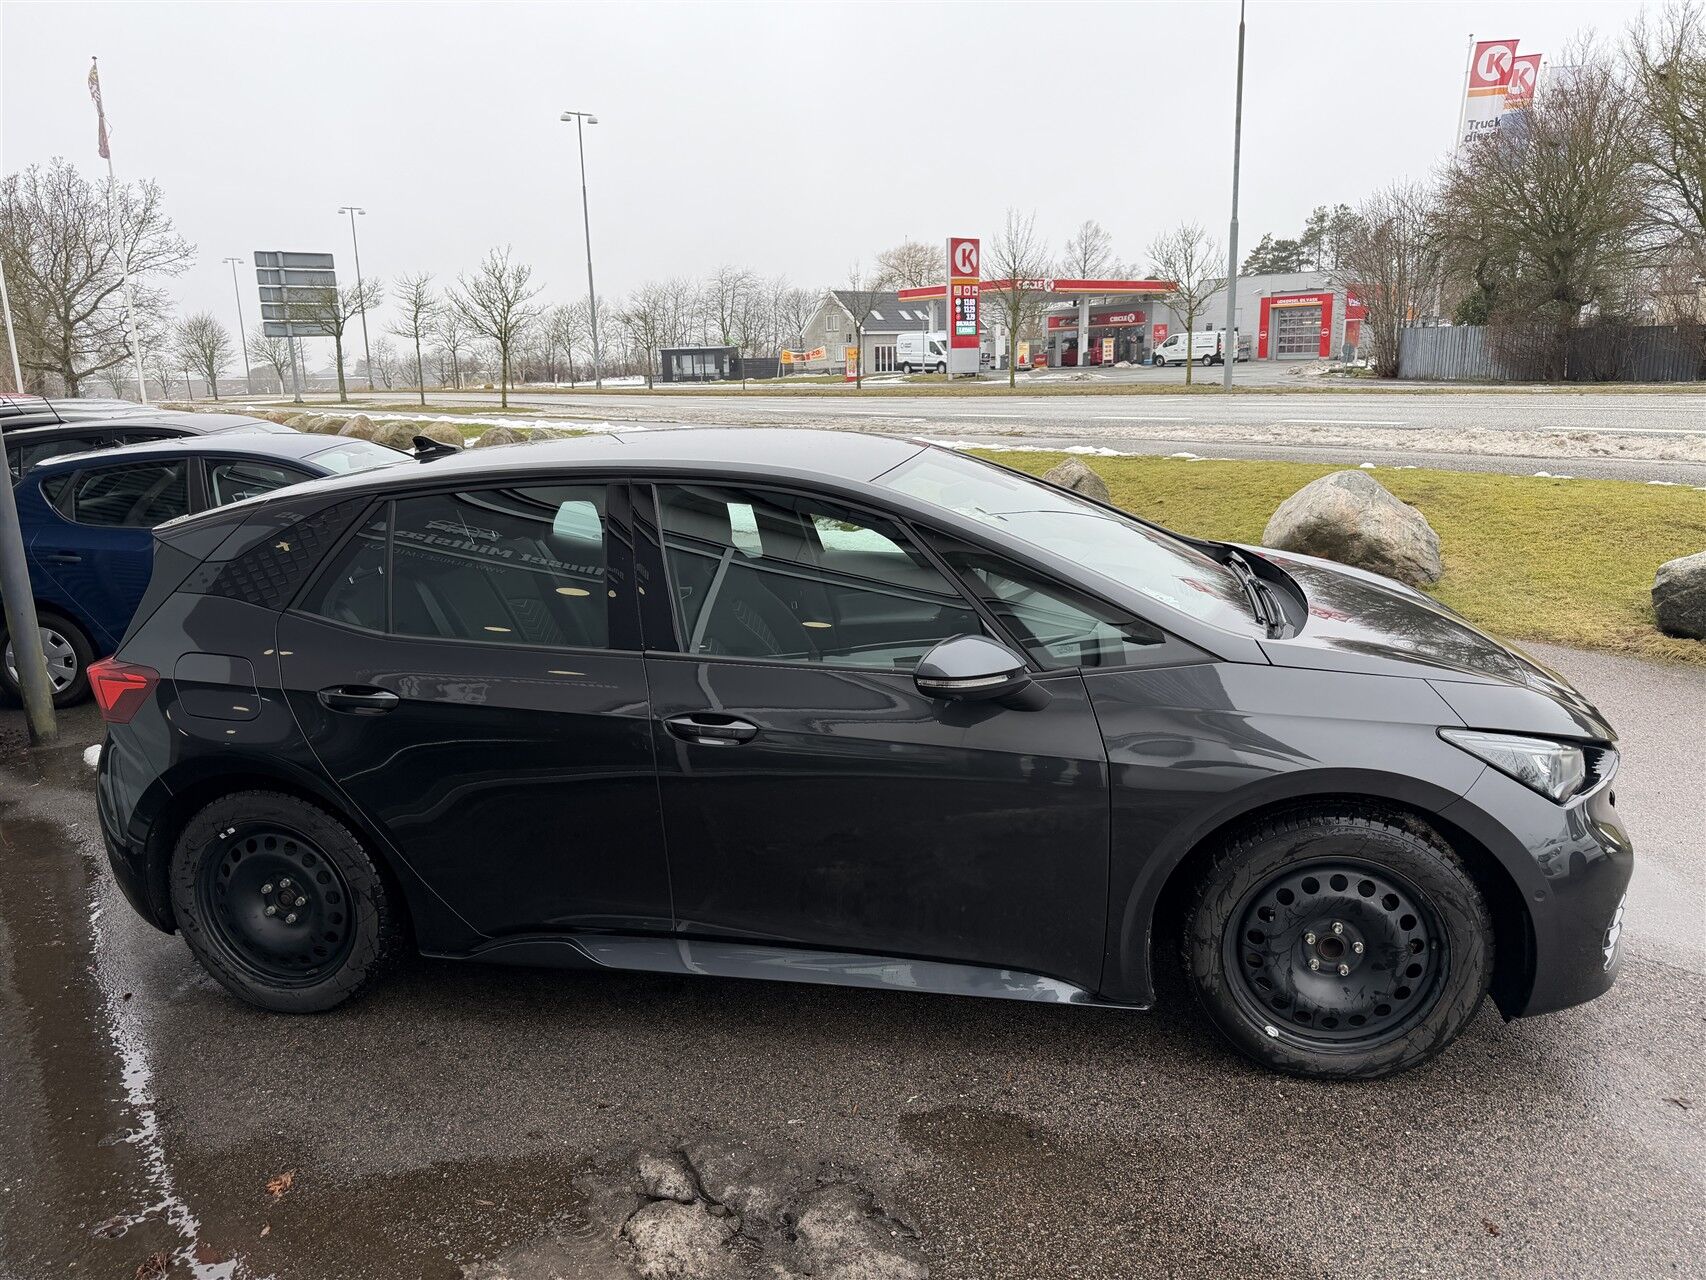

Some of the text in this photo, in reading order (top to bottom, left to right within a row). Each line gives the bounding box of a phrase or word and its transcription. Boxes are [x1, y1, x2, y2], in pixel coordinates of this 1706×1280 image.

[1486, 52, 1507, 80] K
[1511, 67, 1531, 91] K
[1468, 117, 1501, 130] Truck
[961, 248, 976, 269] K
